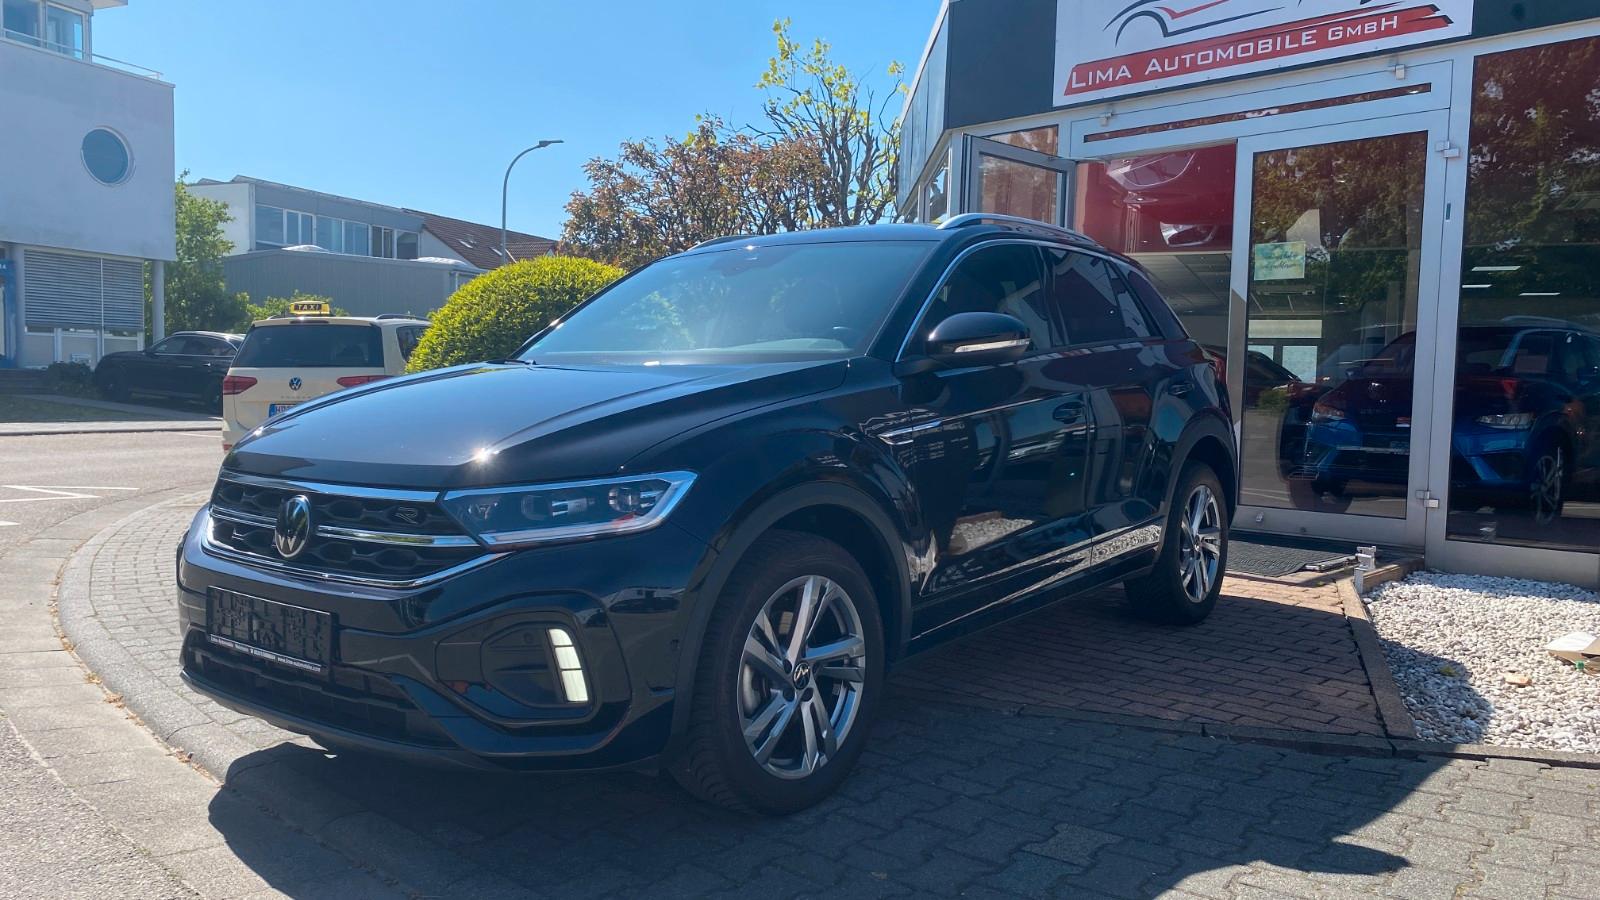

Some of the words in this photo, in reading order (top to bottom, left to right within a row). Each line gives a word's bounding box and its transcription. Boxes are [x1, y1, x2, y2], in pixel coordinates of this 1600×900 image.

[1071, 64, 1132, 89] LIMA
[1144, 29, 1318, 76] AUTOMOBILE
[298, 303, 319, 311] TAXI
